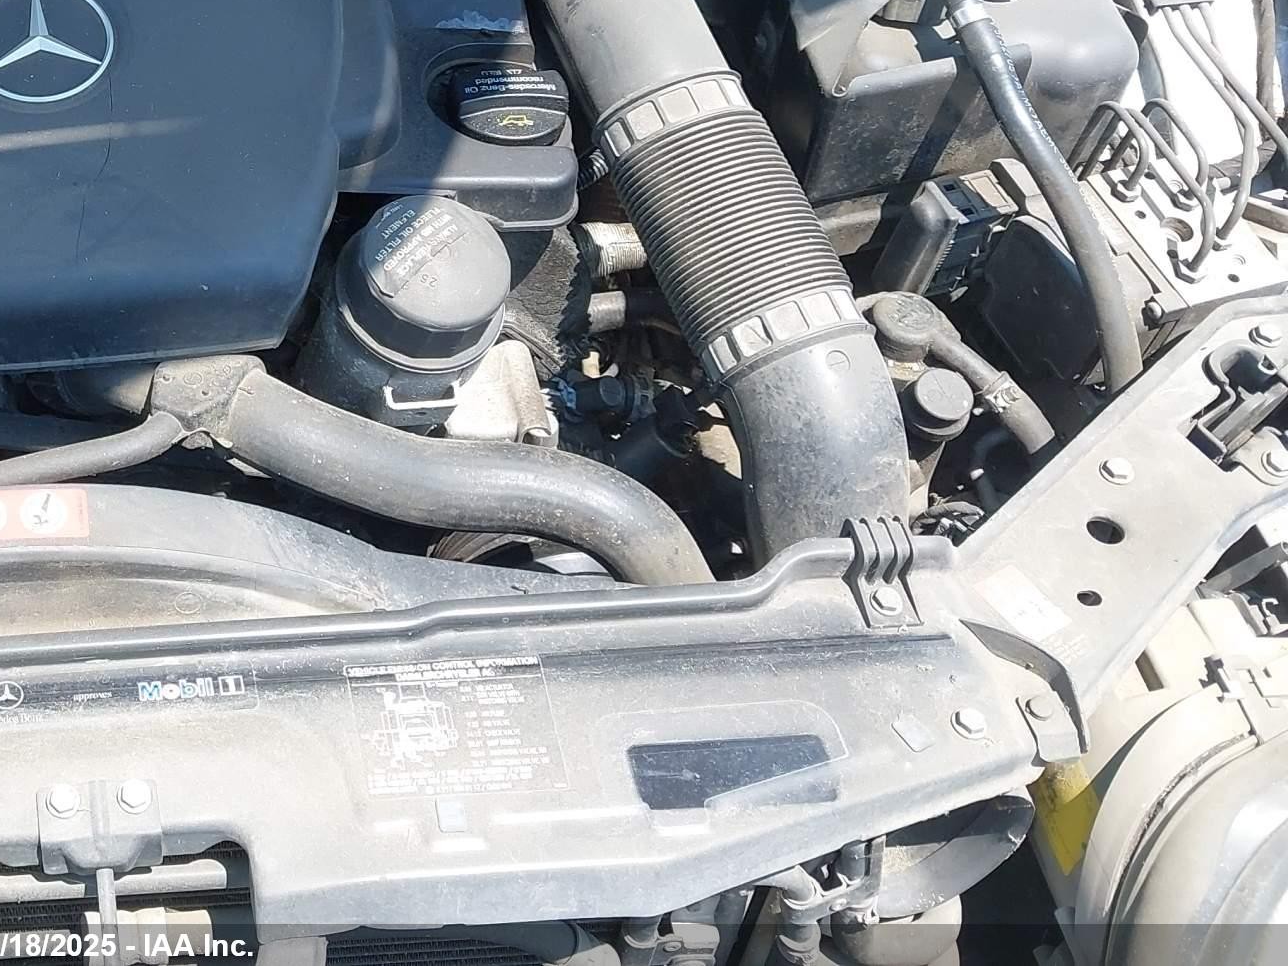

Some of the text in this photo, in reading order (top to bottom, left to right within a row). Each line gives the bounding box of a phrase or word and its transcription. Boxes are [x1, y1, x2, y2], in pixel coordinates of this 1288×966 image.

[464, 83, 557, 94] Mercedes-Benz Oil
[475, 75, 545, 86] recommended
[382, 210, 416, 240] ELEMENT
[411, 207, 441, 229] FLEECE
[398, 227, 414, 240] OIL
[375, 237, 401, 262] FILTER
[383, 235, 423, 271] APPROVED
[396, 245, 431, 276] REPLACE
[431, 660, 475, 671] CONTROL
[476, 656, 538, 668] INFORMATION
[73, 691, 112, 702] approves
[138, 677, 214, 701] Mobil
